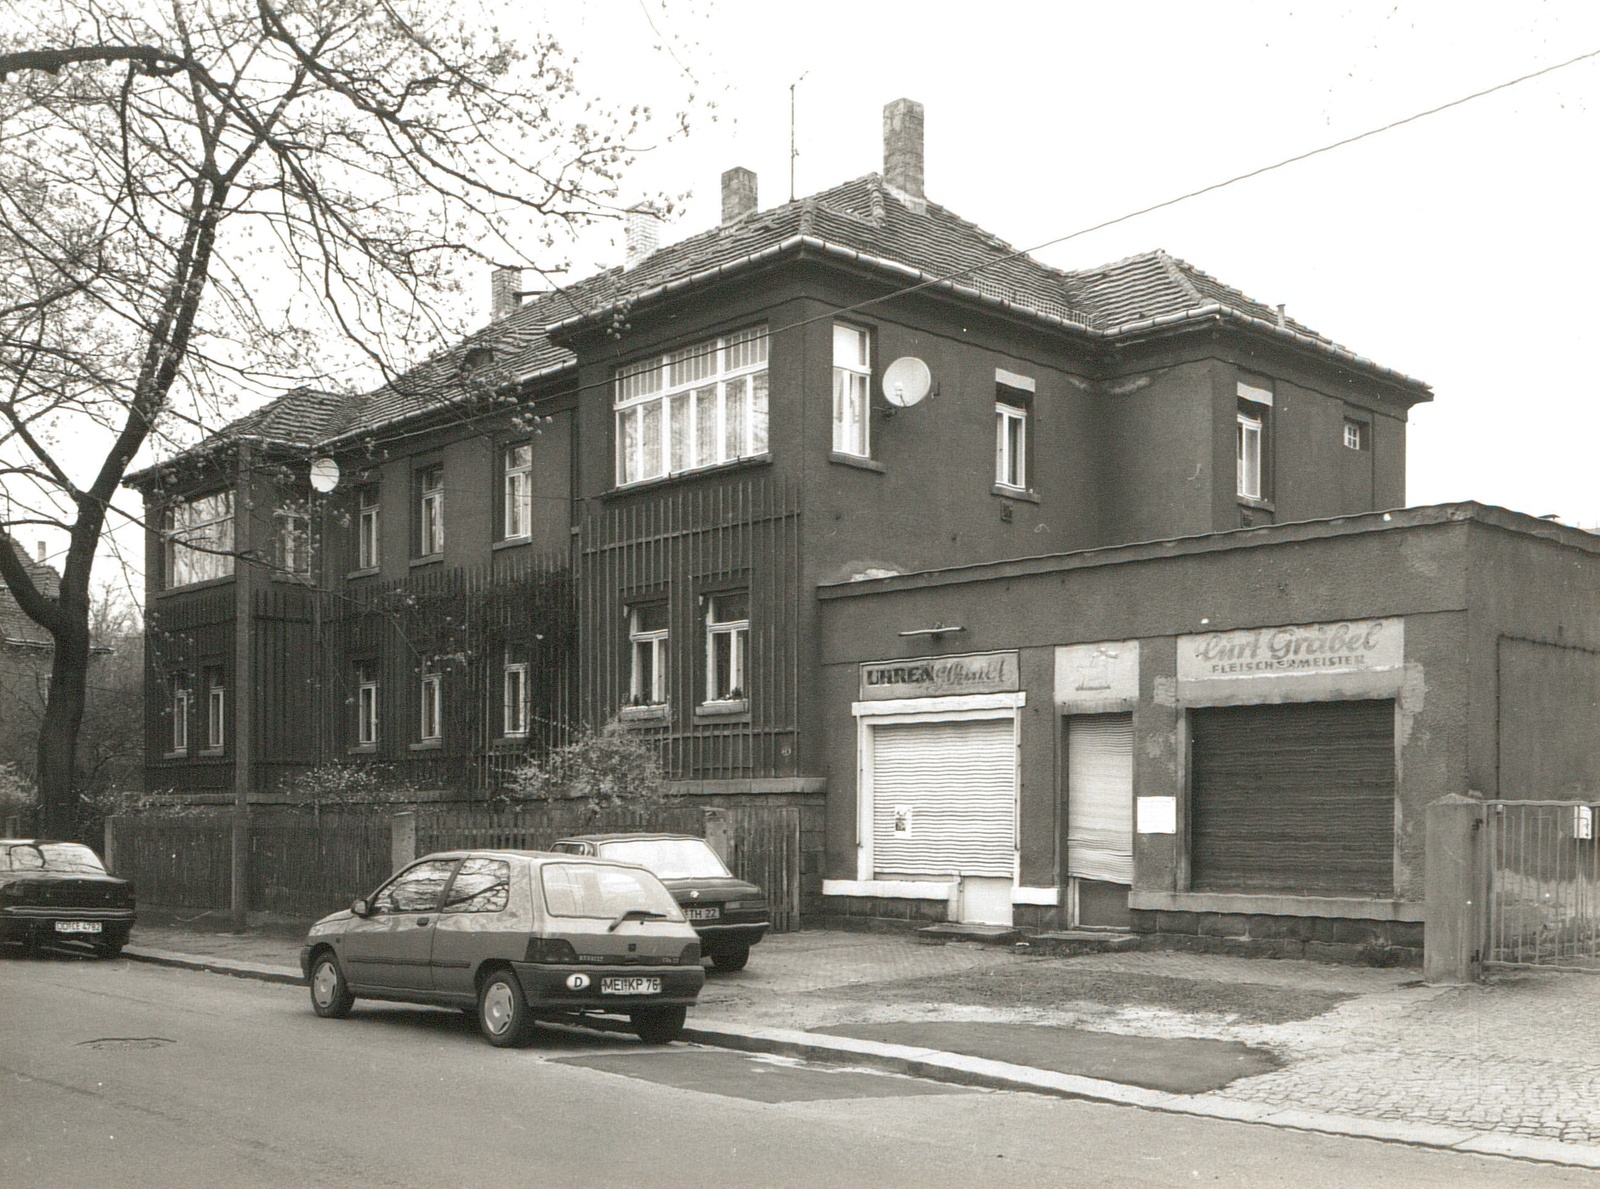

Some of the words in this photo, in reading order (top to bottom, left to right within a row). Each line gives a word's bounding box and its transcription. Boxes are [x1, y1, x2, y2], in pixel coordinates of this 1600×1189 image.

[867, 665, 936, 686] UHREN
[705, 908, 716, 918] 22
[574, 976, 583, 988] D
[646, 978, 658, 991] 76
